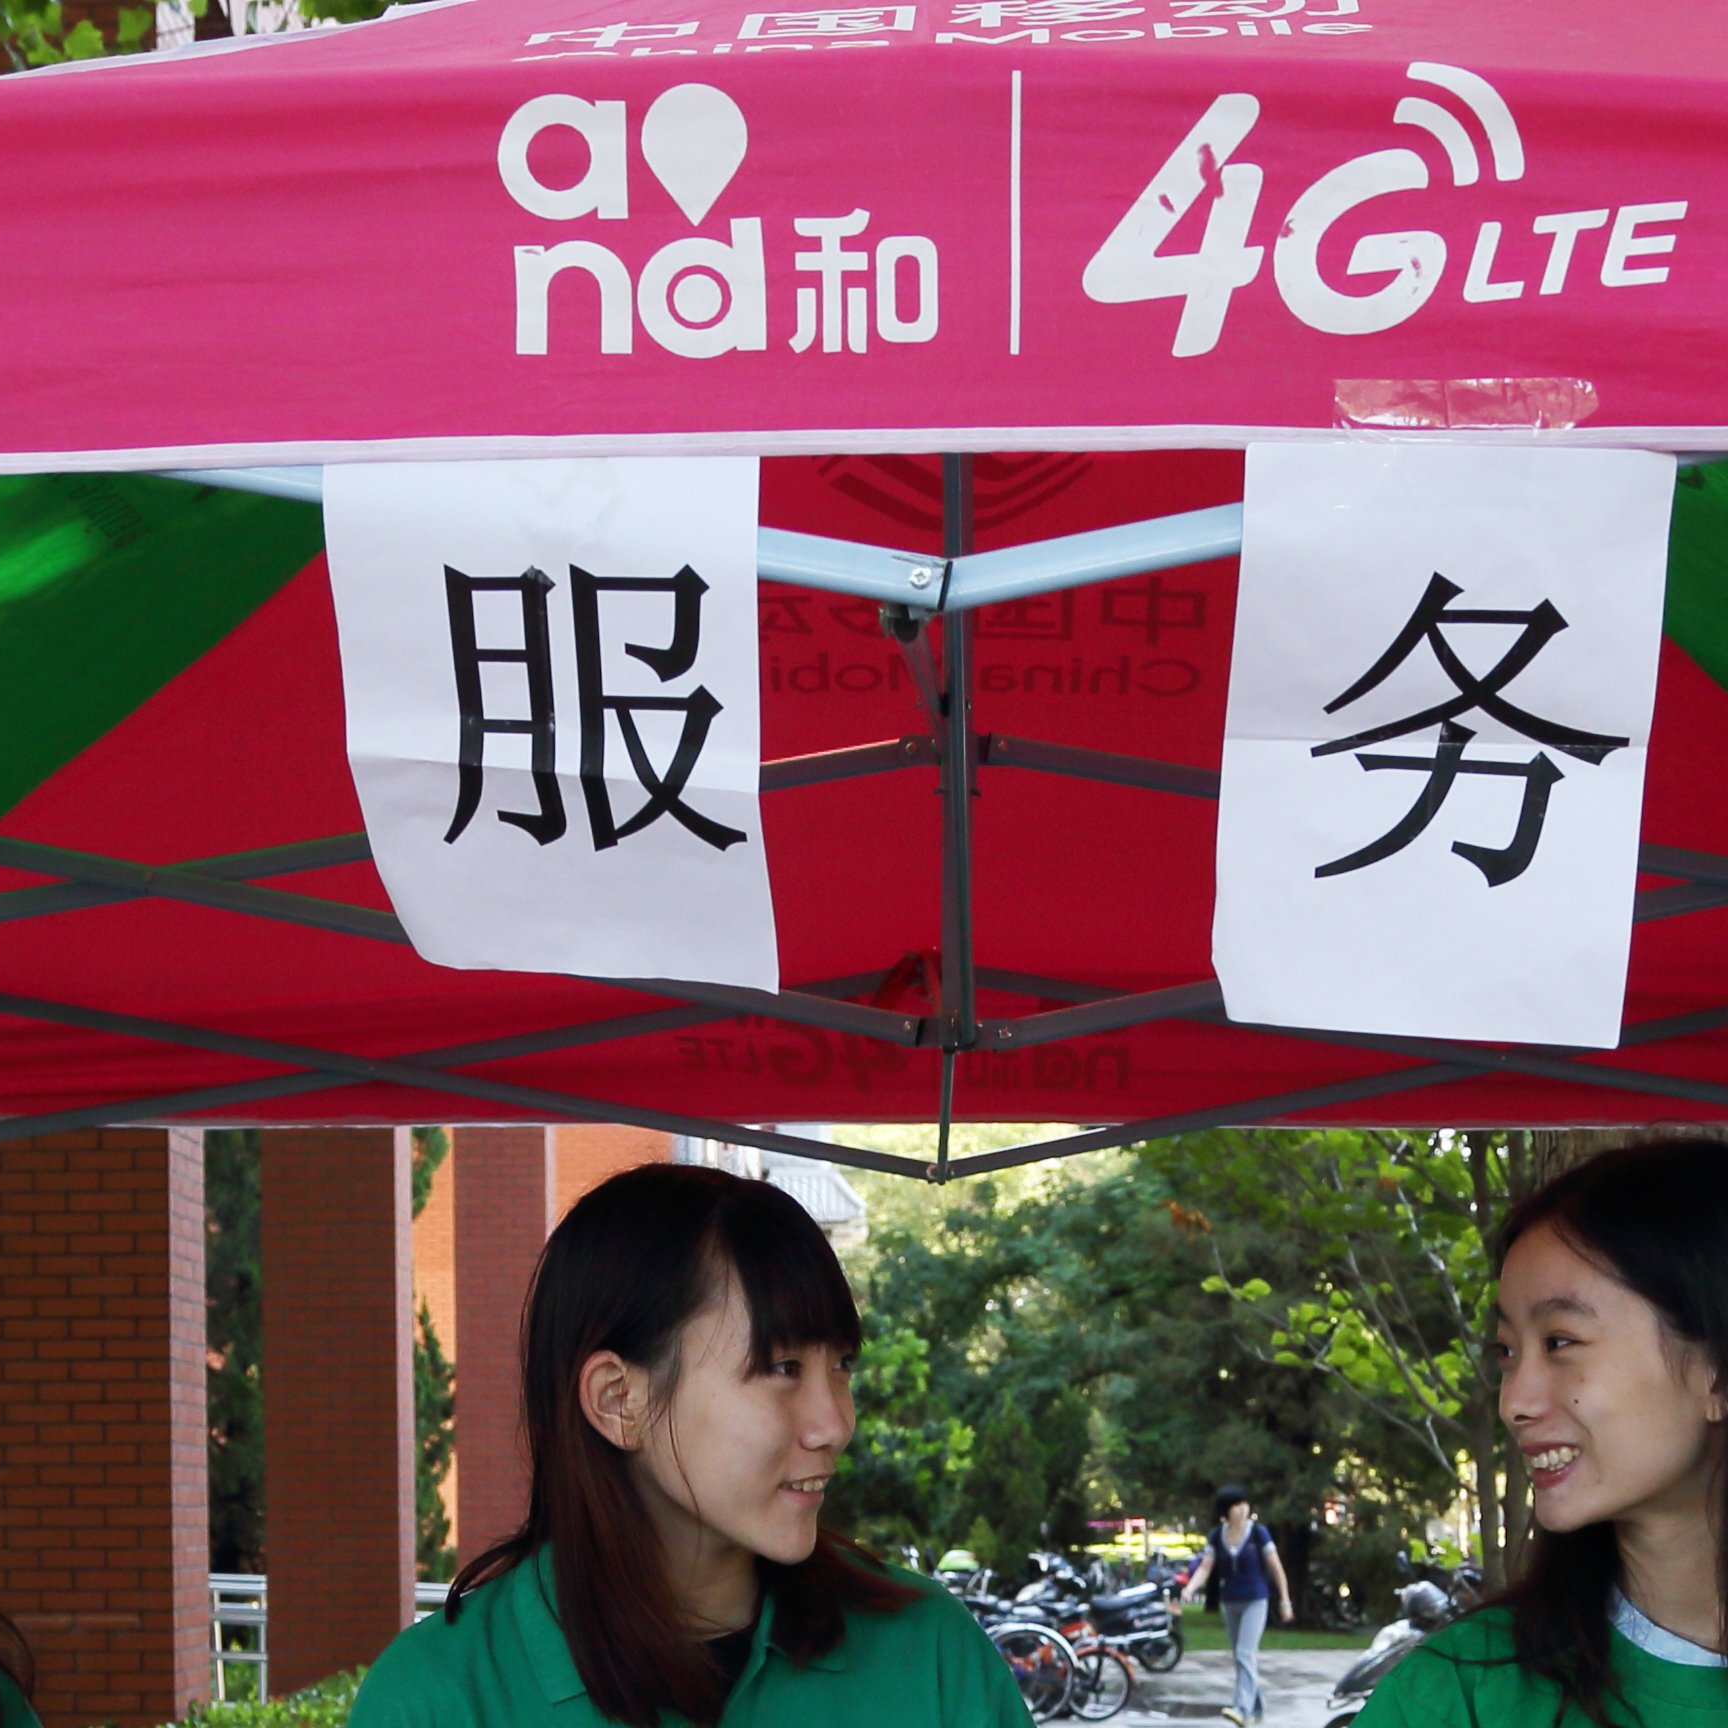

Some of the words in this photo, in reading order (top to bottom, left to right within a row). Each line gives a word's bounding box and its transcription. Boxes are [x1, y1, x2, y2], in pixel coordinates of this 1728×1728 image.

[934, 19, 1374, 45] Mobile
[788, 207, 939, 354] 和
[1081, 93, 1447, 358] 4G
[1462, 200, 1689, 303] LTE
[443, 562, 748, 852] 服
[1310, 570, 1631, 888] 务
